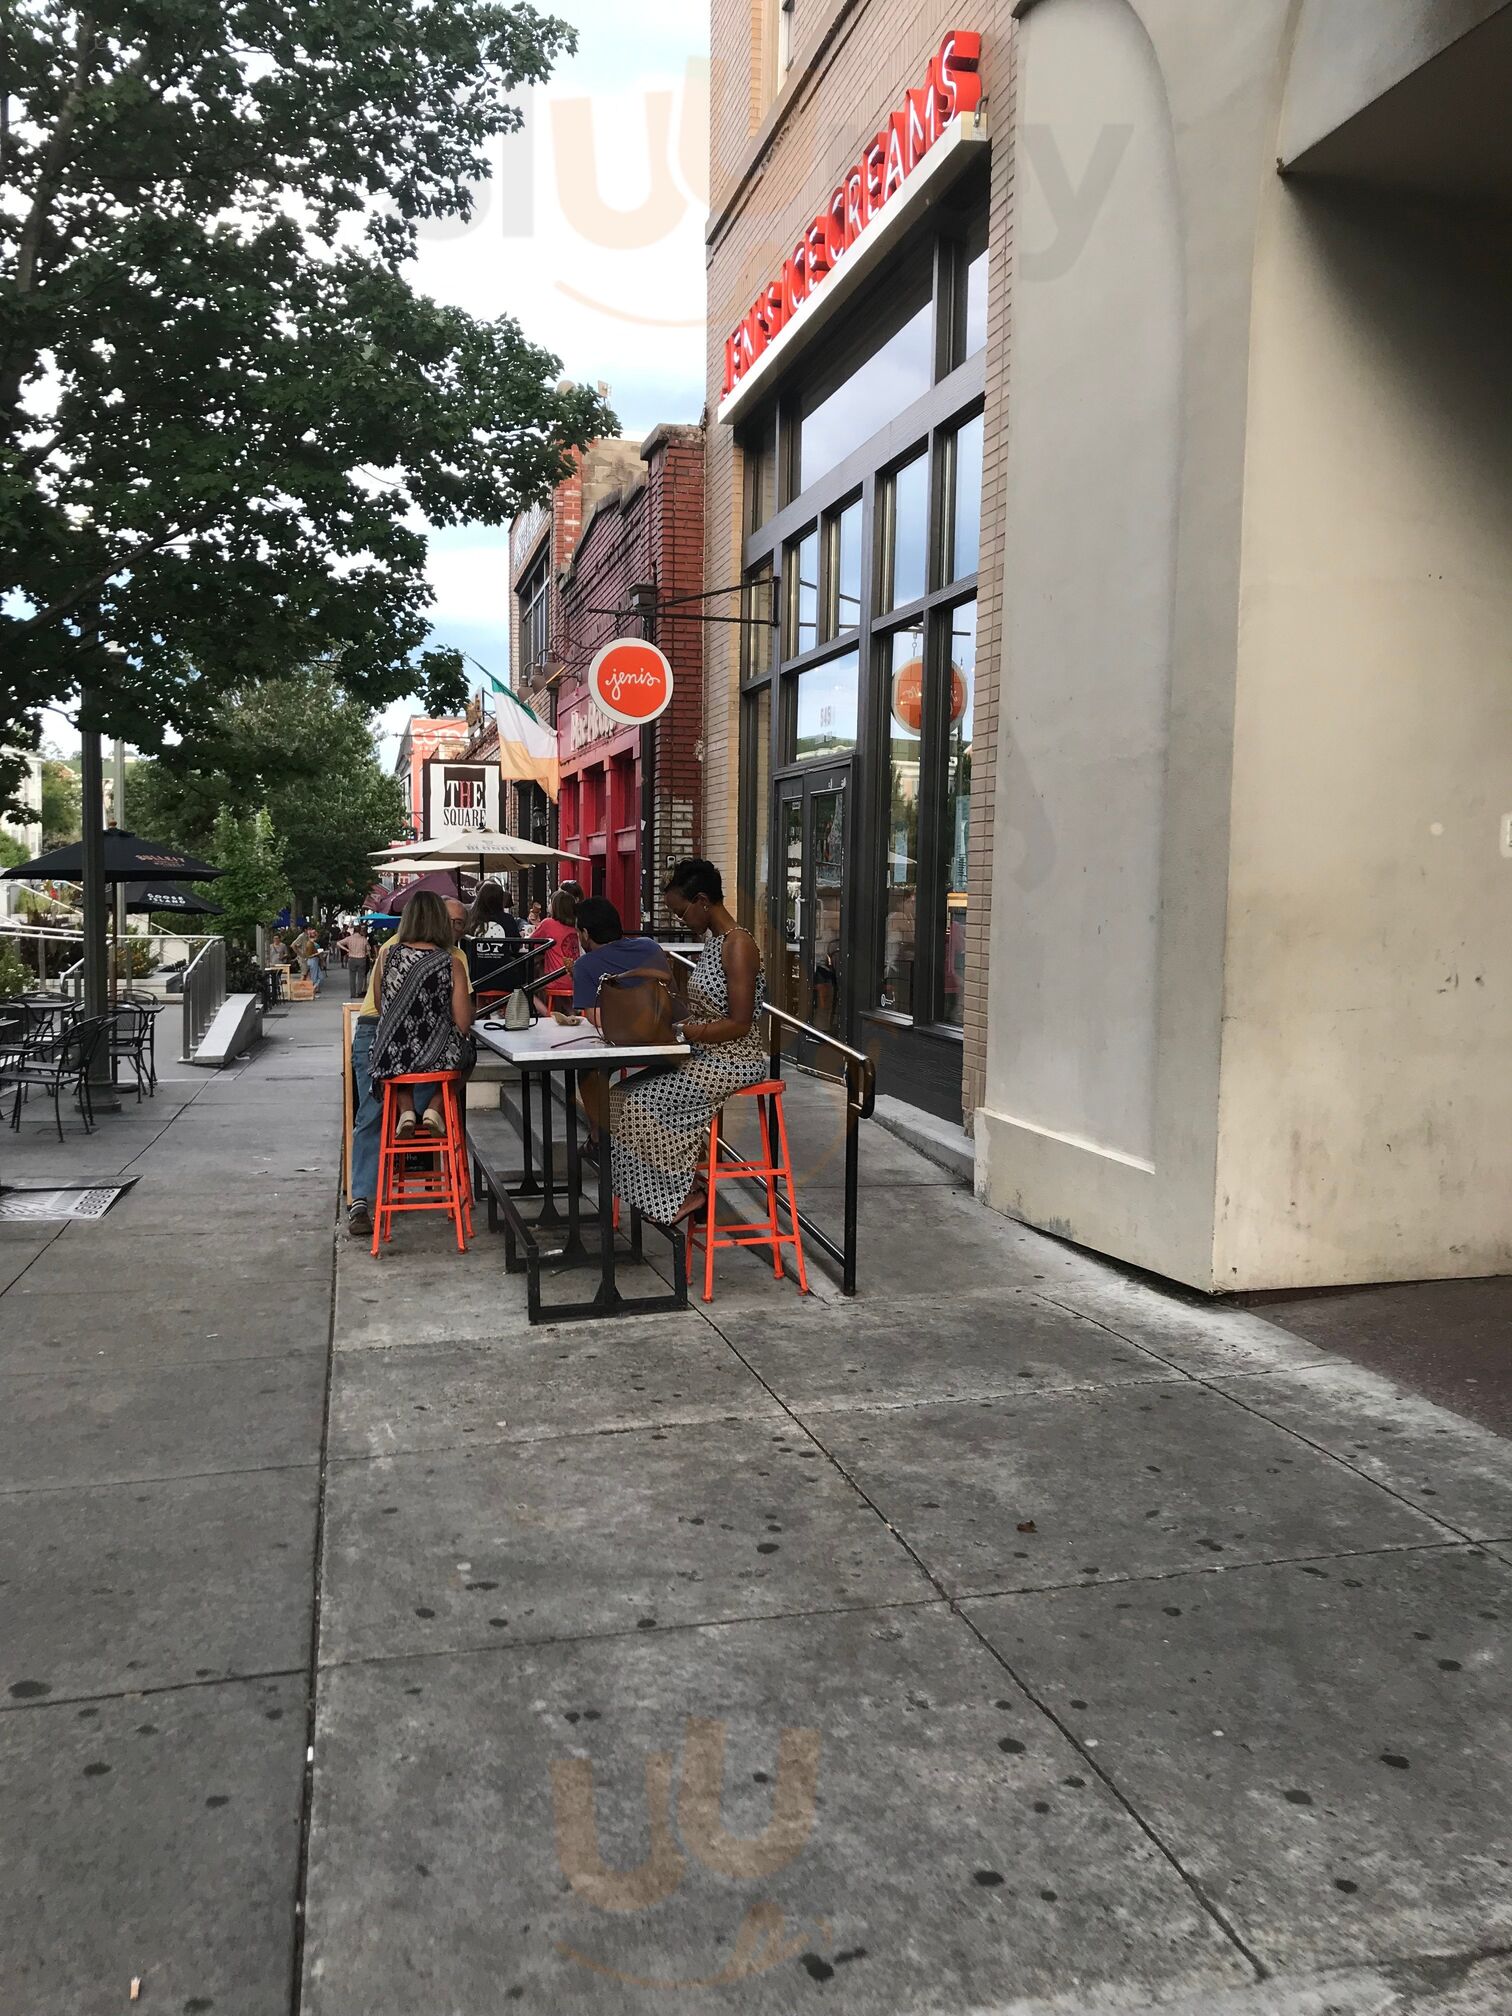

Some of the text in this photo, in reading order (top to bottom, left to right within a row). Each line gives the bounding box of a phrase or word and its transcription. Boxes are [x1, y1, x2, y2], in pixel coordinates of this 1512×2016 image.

[824, 31, 982, 270] CREAMS
[605, 667, 660, 700] jenis
[446, 780, 484, 808] THE
[443, 808, 487, 827] SQUARE
